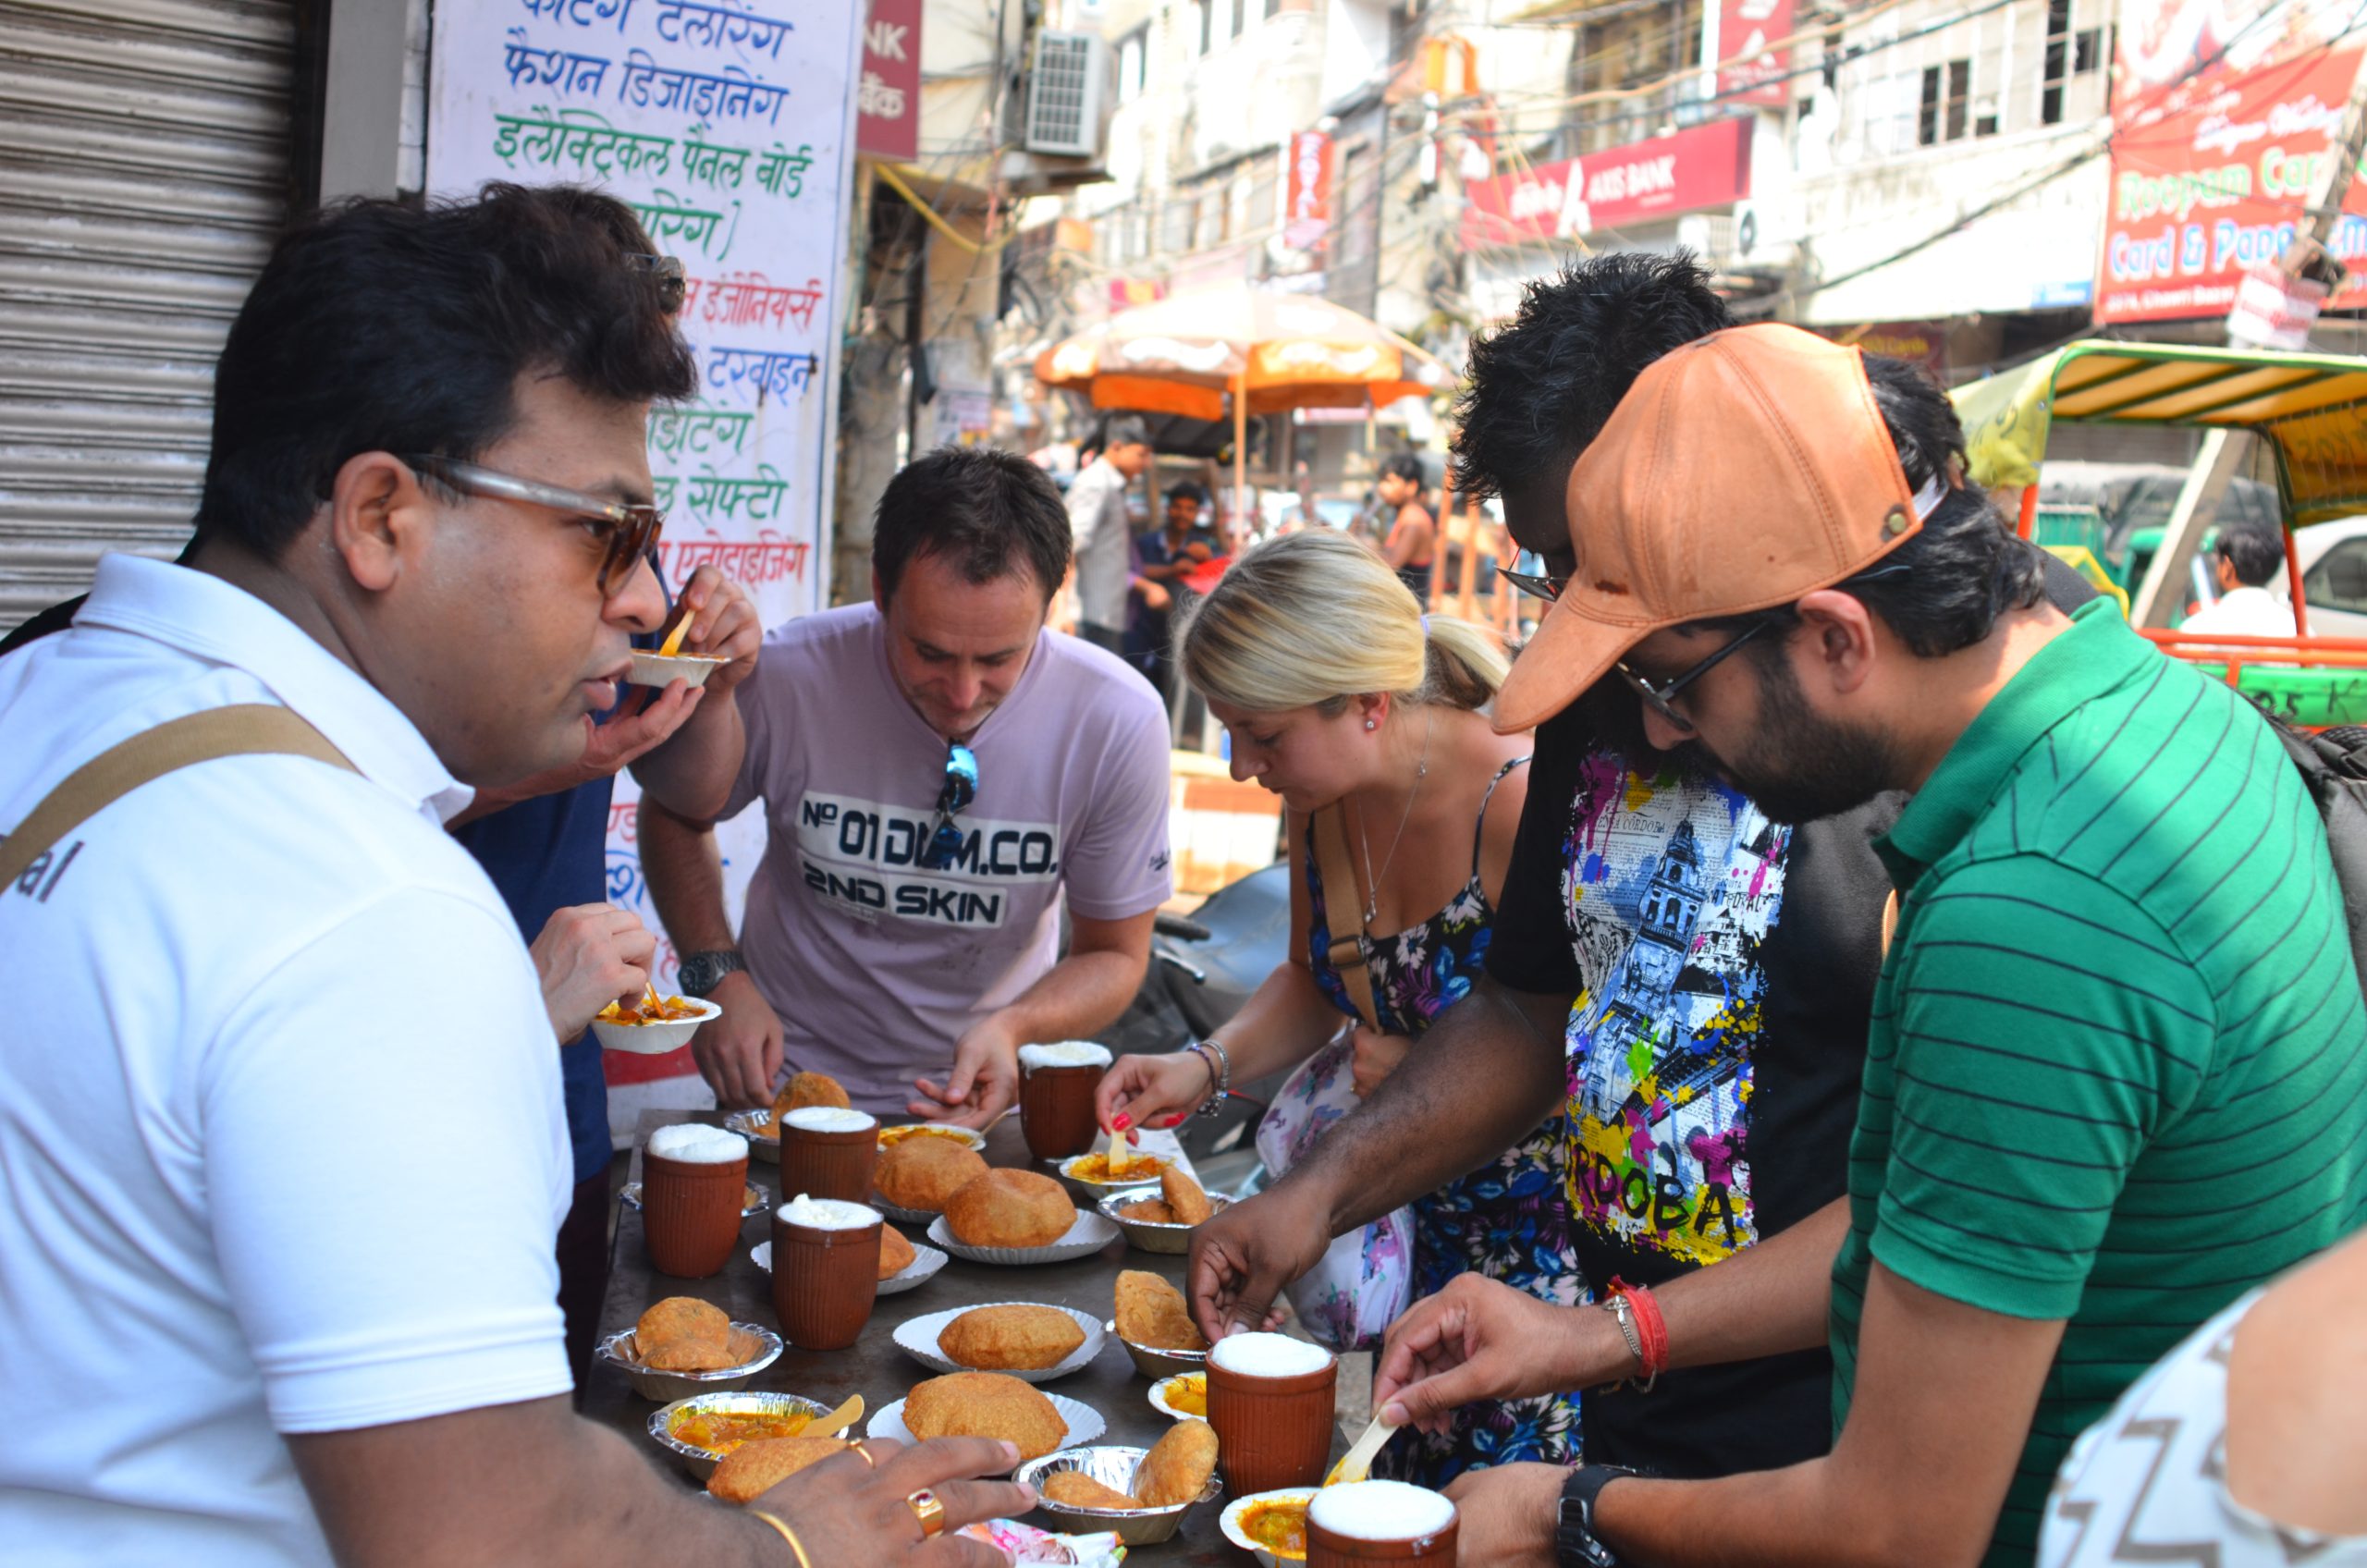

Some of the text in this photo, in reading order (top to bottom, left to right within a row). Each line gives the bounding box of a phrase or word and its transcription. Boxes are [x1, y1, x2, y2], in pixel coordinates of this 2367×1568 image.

[503, 26, 611, 101] फैशन
[681, 123, 751, 190] पैनल
[1627, 153, 1675, 197] BANK
[2110, 226, 2175, 281] Card
[2180, 224, 2206, 276] &
[803, 861, 886, 909] 2ND
[894, 884, 1001, 924] SKIN
